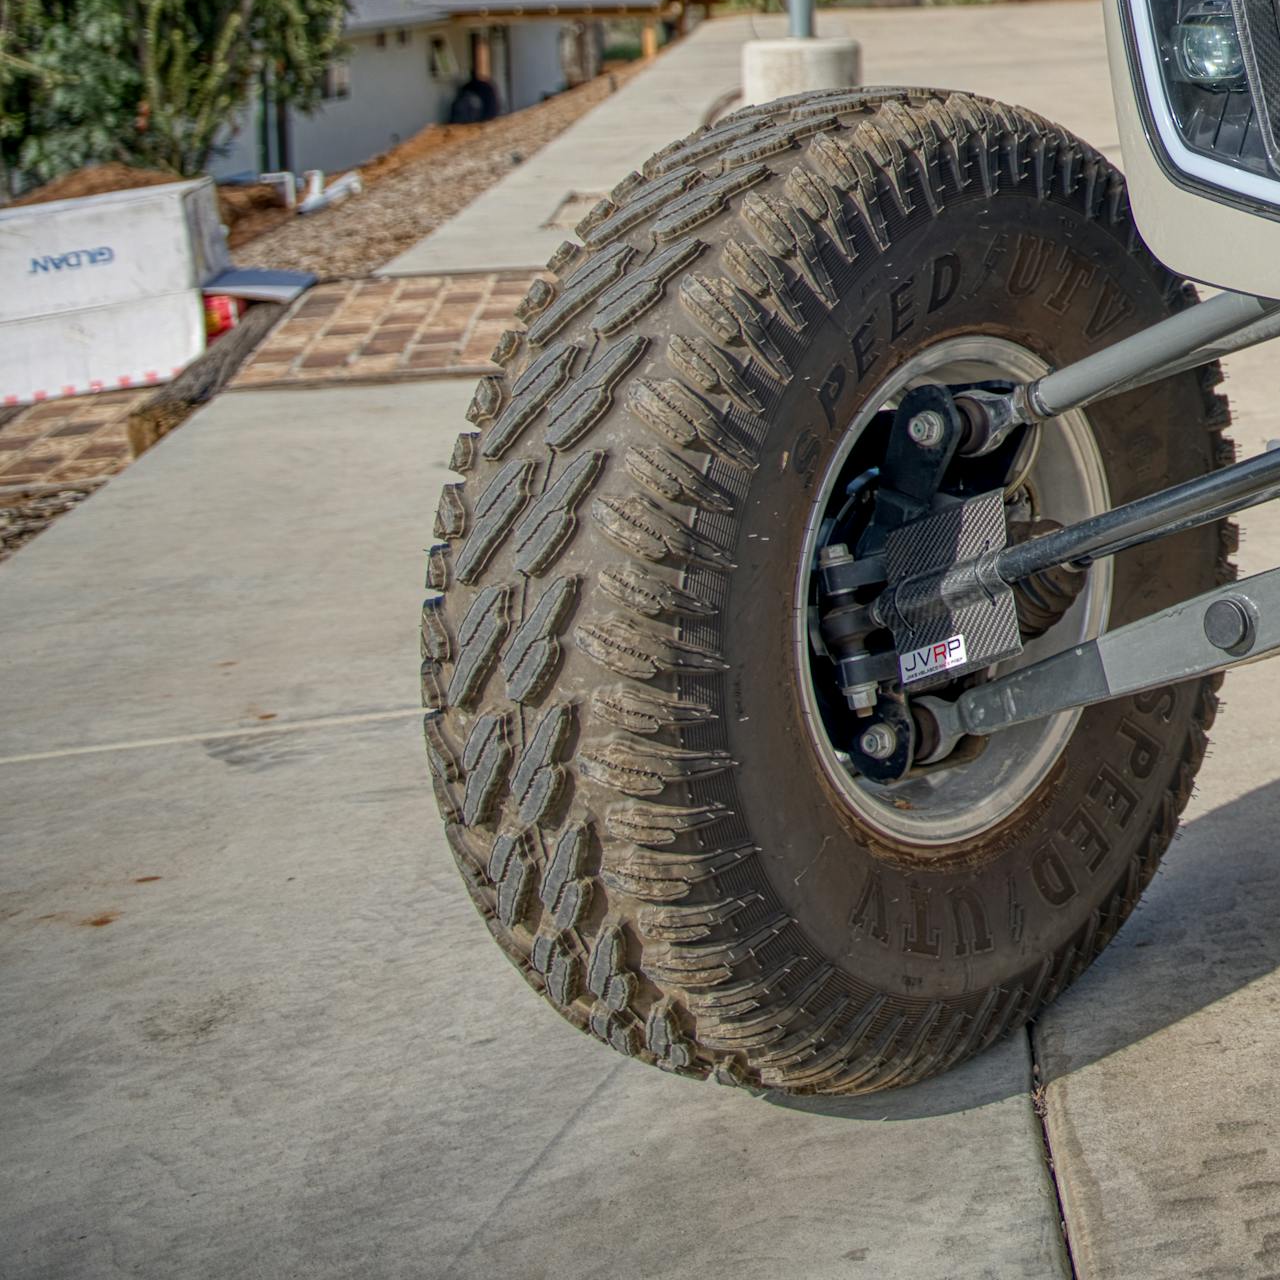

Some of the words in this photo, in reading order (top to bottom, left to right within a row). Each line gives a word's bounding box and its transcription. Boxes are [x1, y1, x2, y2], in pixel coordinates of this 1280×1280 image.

[794, 248, 961, 486] SPEED
[1006, 233, 1135, 343] UTV
[905, 638, 961, 672] JVRP
[1030, 686, 1178, 907] SPEED
[848, 875, 994, 960] UTV
